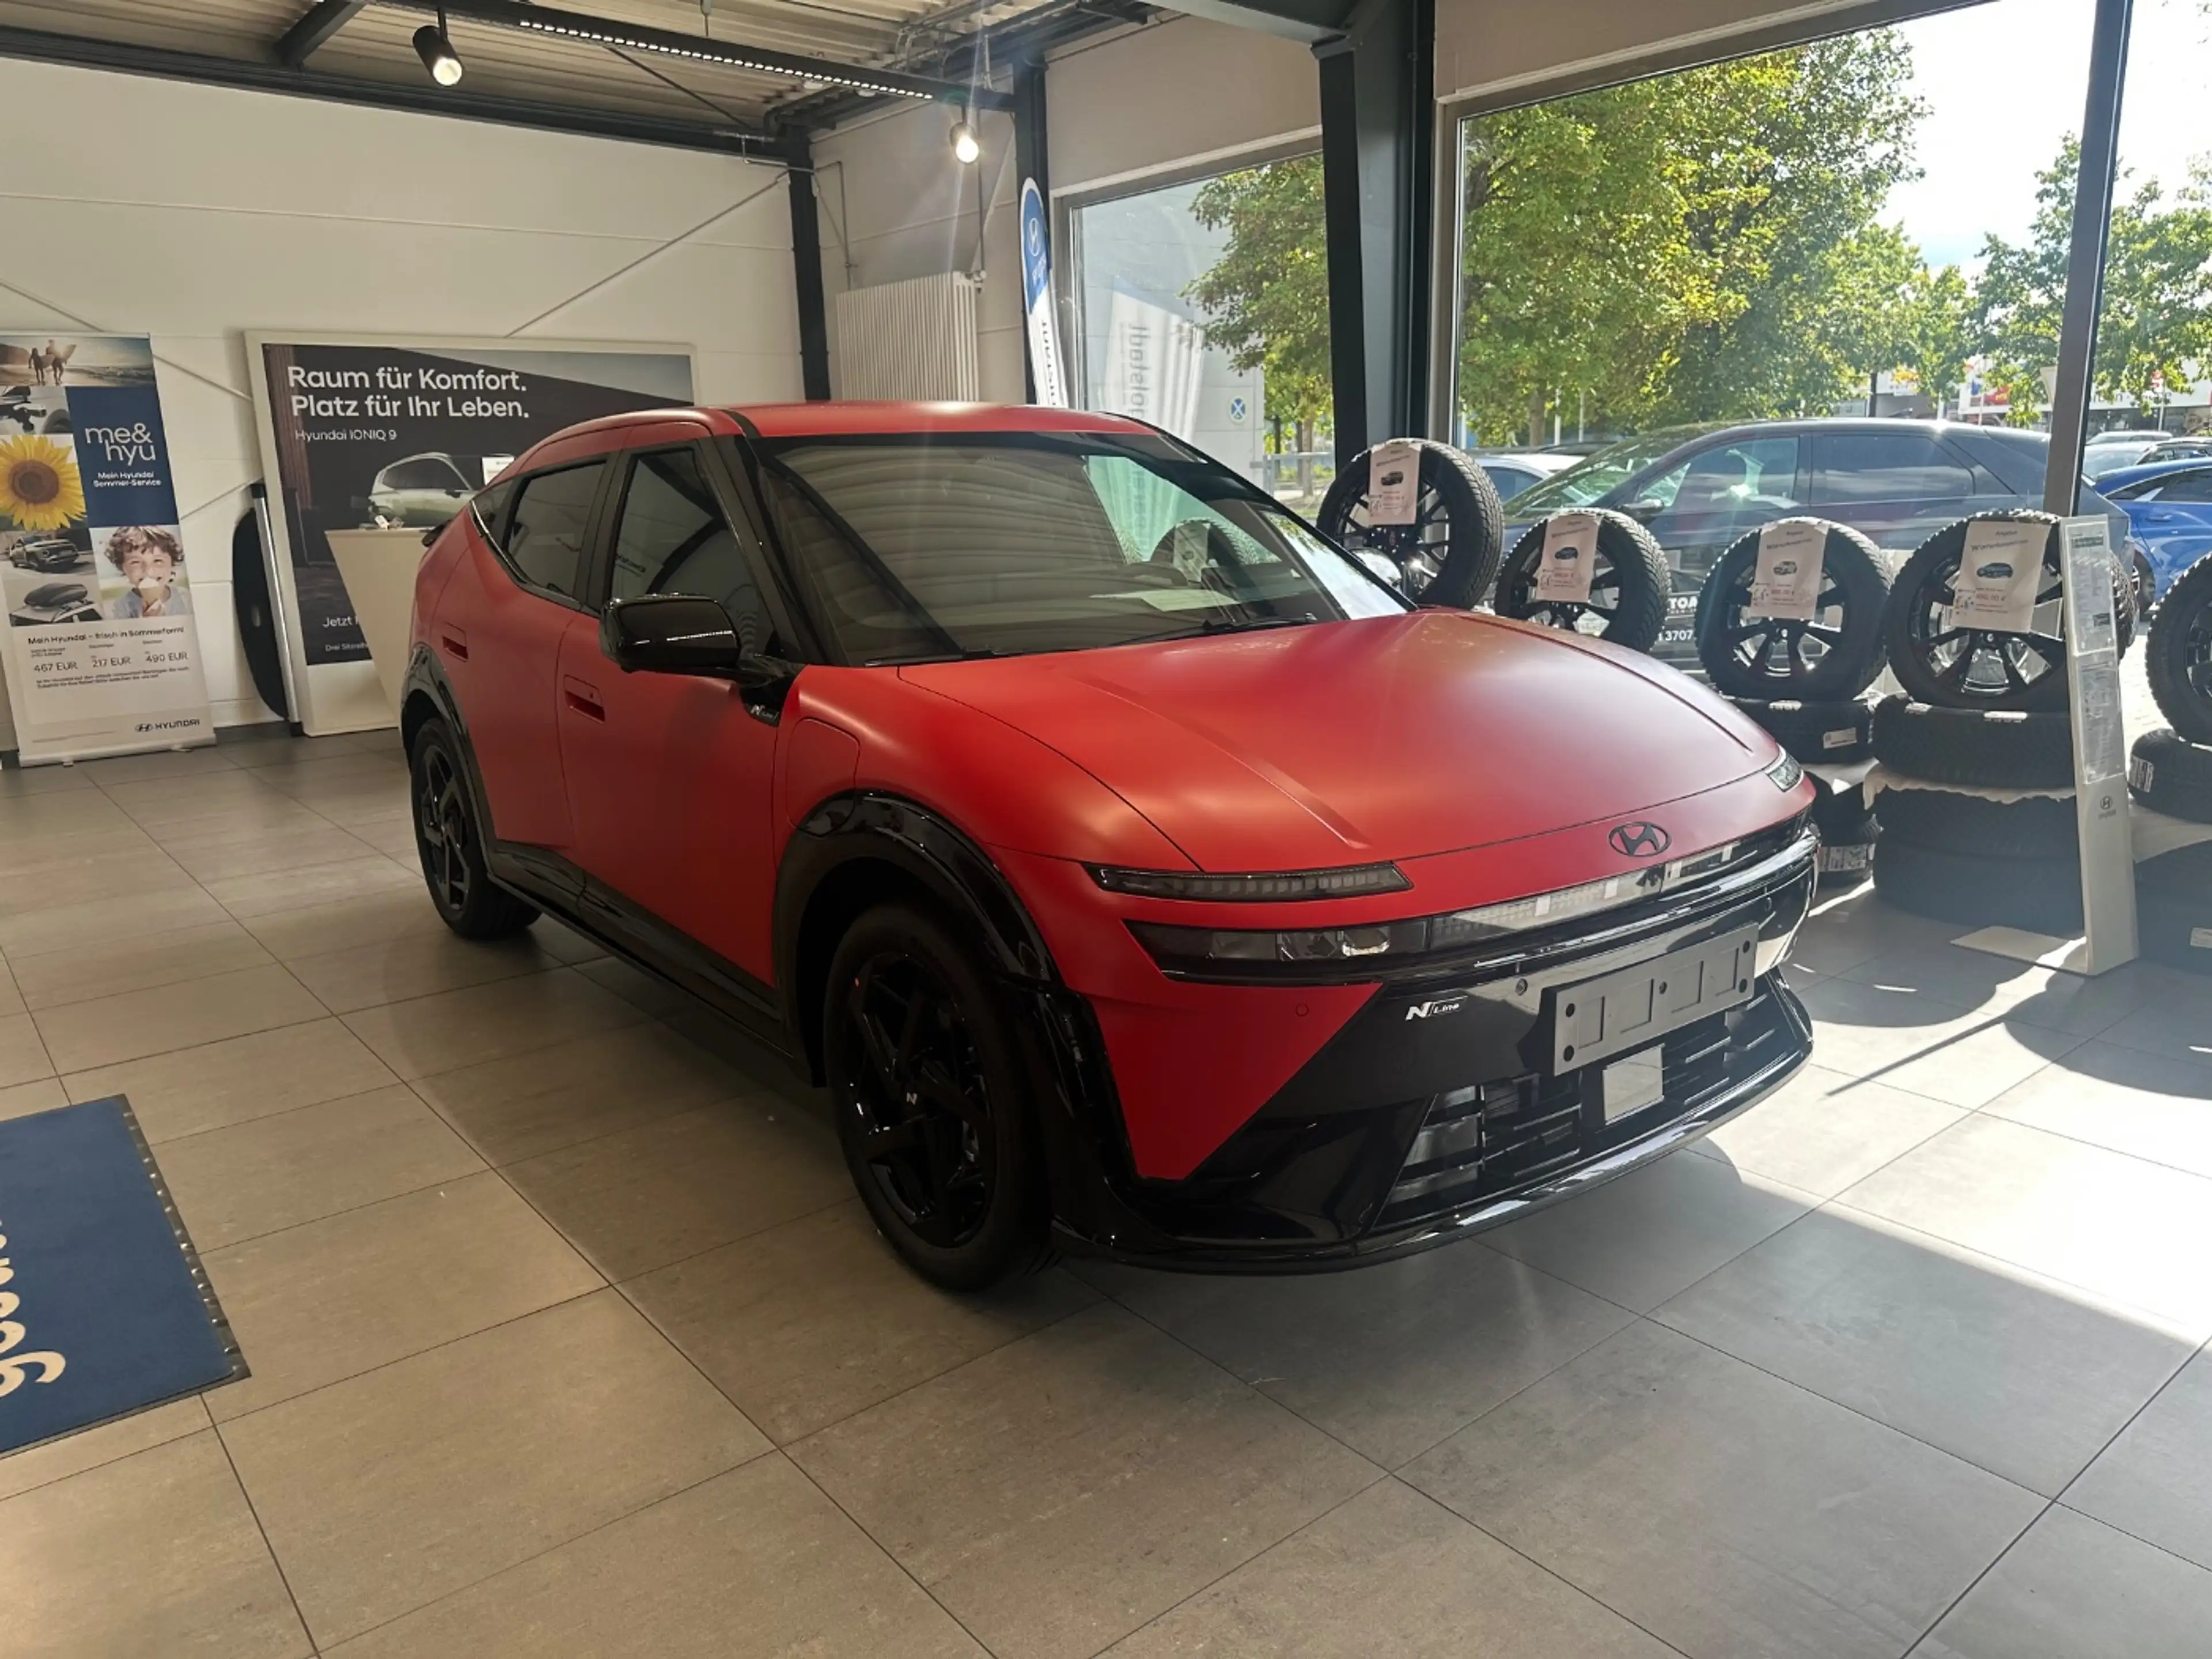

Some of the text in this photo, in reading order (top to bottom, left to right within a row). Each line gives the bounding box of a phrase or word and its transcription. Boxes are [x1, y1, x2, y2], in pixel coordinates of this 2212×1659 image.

[287, 366, 527, 391] Raum für Komfort.
[291, 395, 529, 418] Platz für Ihr Leben.
[85, 422, 153, 444] me&
[295, 429, 397, 442] Hyundai IONIQ 9
[104, 439, 156, 466] hyu
[120, 471, 154, 479] Hyundai
[322, 615, 353, 628] Jetzt
[51, 634, 86, 643] Hyundai
[1665, 630, 1694, 641] 3707
[56, 661, 79, 671] EUR
[92, 658, 108, 668] 217
[111, 656, 131, 666] EUR
[145, 654, 165, 662] 490
[168, 652, 188, 661] EUR
[154, 718, 200, 729] HYUNDAI
[1405, 1002, 1431, 1020] N
[906, 1092, 918, 1105] N
